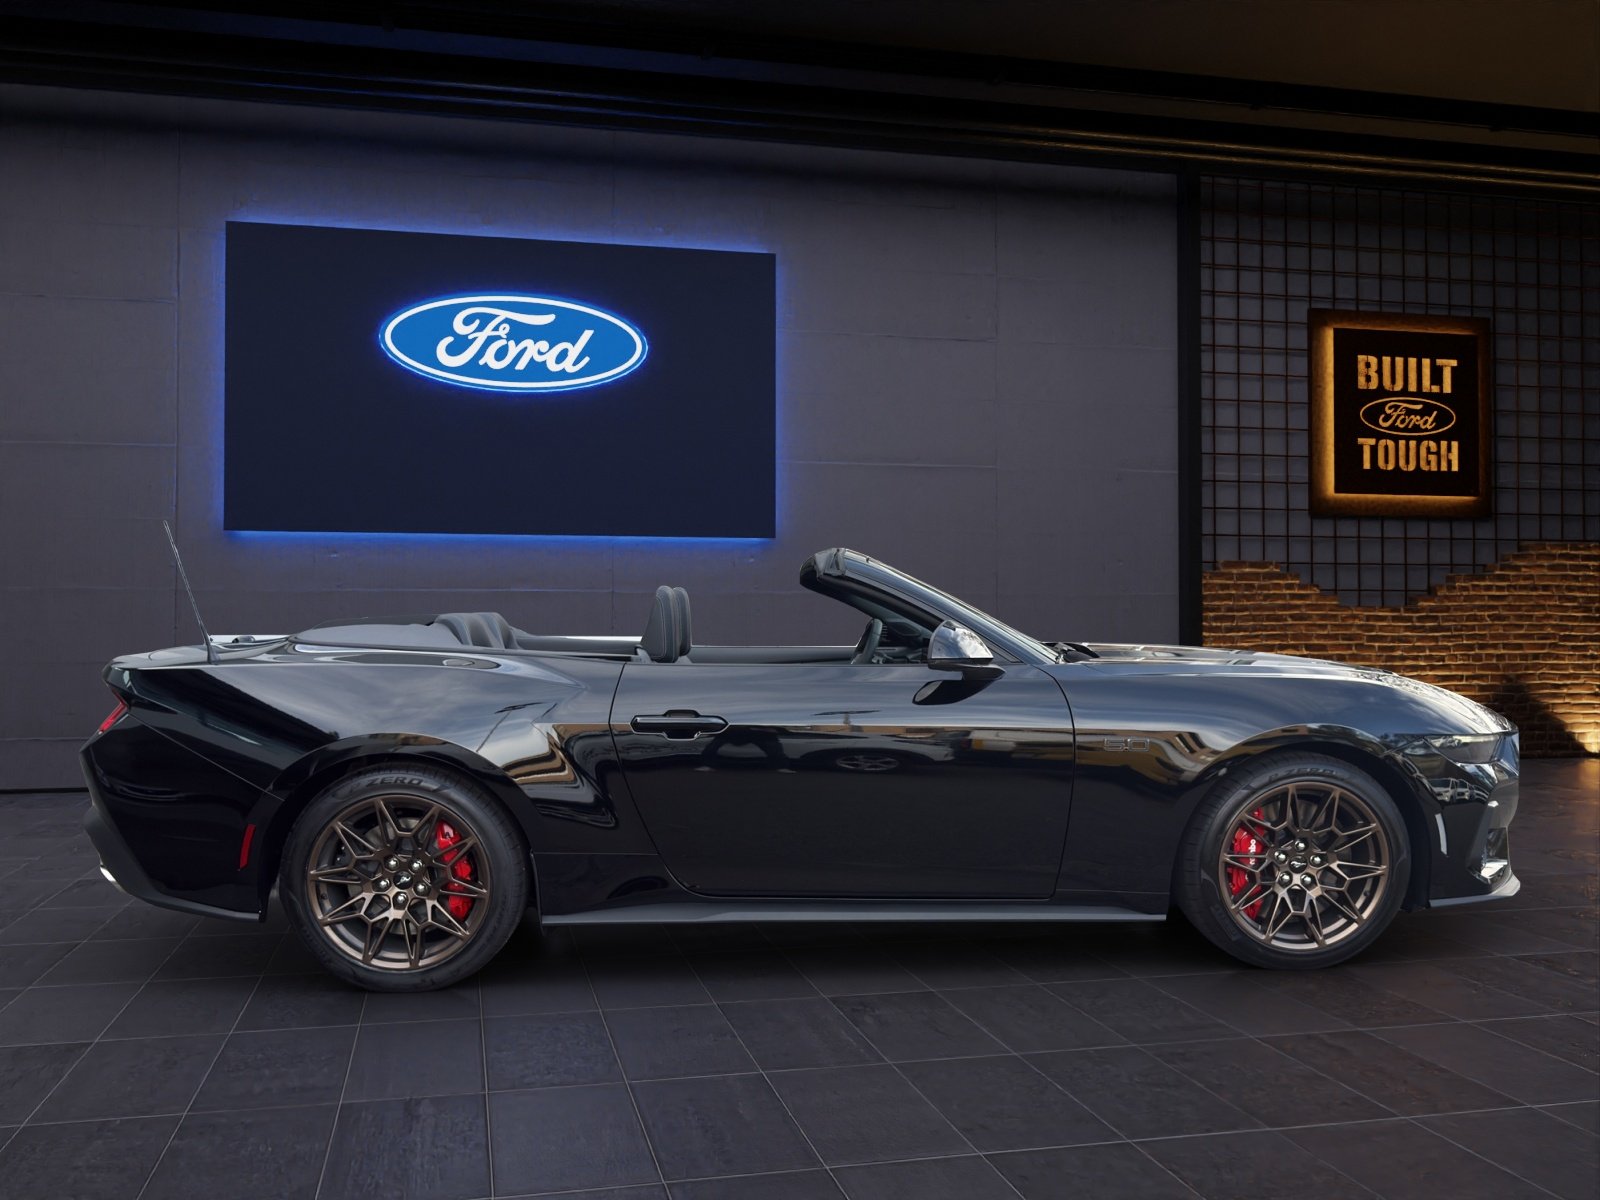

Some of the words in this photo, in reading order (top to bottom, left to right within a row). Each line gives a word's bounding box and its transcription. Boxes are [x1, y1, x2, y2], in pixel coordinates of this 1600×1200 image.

[436, 307, 594, 373] Ford
[1357, 355, 1458, 394] BUILT
[1379, 402, 1437, 430] Ford
[1357, 438, 1459, 472] TOUGH
[1104, 738, 1150, 752] 5.0
[367, 776, 424, 786] ZERO
